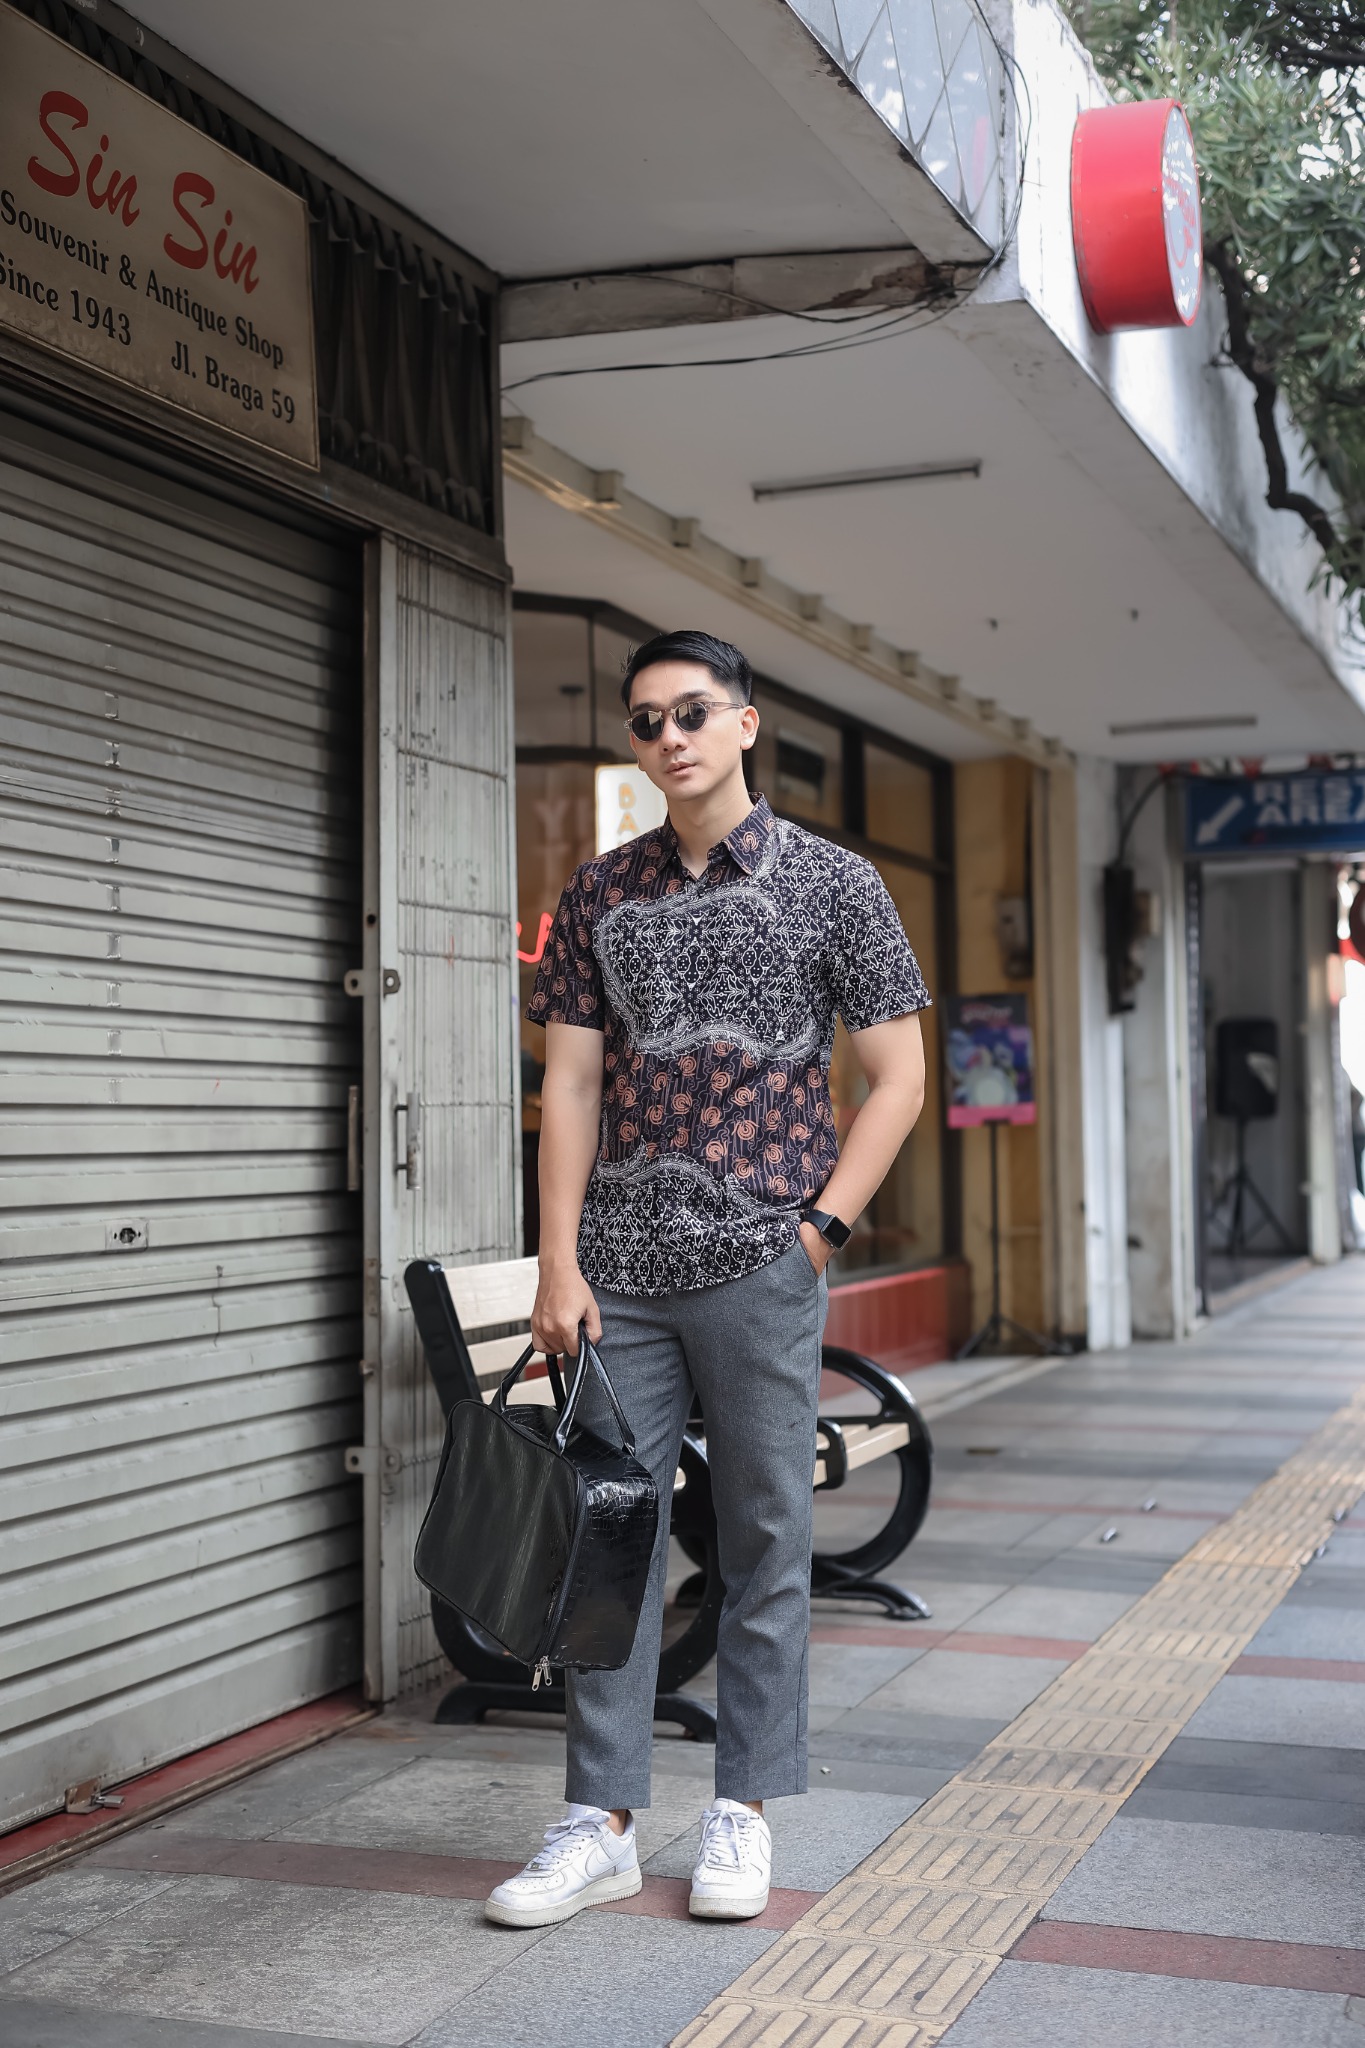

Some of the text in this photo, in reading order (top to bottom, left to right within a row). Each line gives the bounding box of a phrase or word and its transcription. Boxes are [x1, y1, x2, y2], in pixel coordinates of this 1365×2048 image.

[27, 90, 260, 294] Sin Sin
[0, 189, 285, 369] Souvenir & Antique Shop
[70, 289, 132, 346] 1943
[170, 340, 296, 424] Jl. Braga 59
